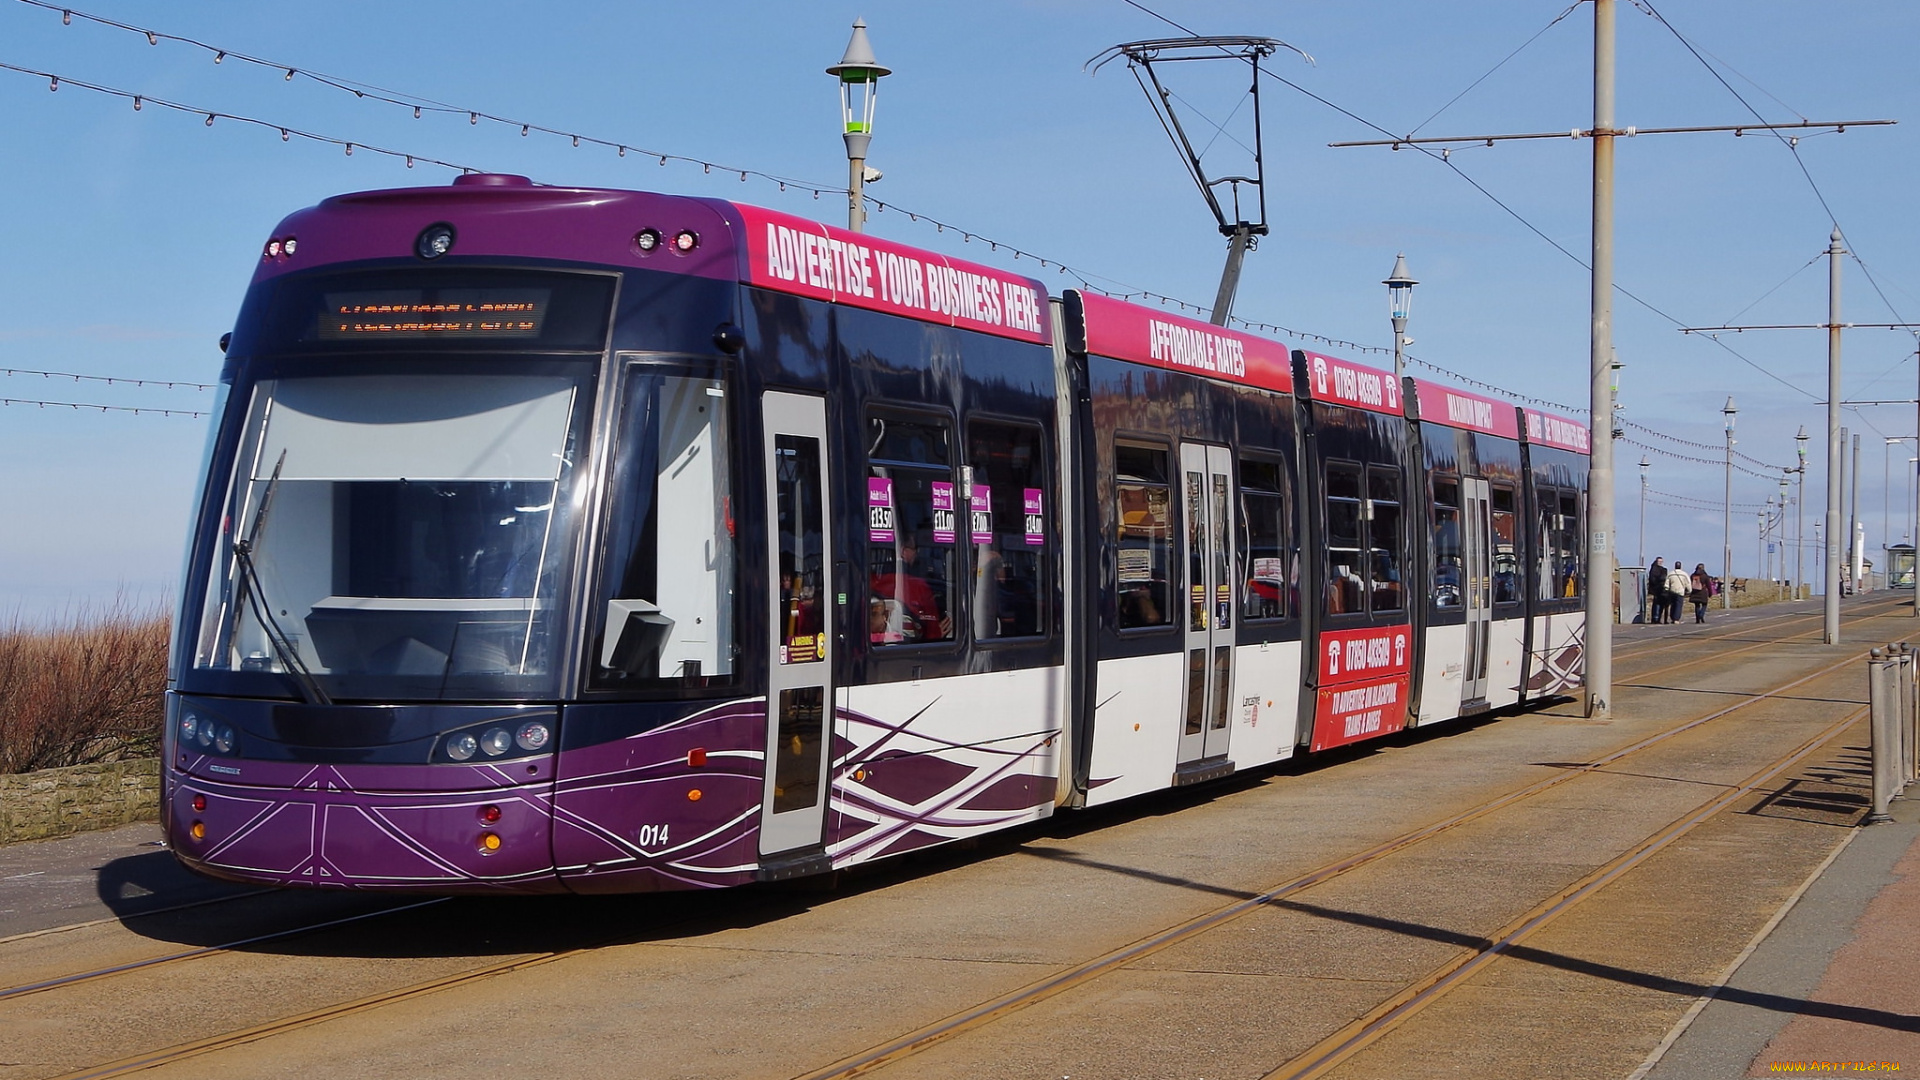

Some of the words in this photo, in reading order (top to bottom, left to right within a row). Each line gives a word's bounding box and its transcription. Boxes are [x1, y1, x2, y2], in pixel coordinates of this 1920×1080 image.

[766, 222, 874, 299] ADVERTISE
[874, 249, 926, 310] YOUR
[926, 262, 1001, 327] BUSINESS
[1002, 281, 1042, 334] HERE
[1149, 318, 1216, 372] AFFORDABLE
[1214, 334, 1246, 378] RATES
[871, 507, 892, 529] £13.50
[935, 510, 955, 531] £11.00
[972, 512, 988, 532] £7.00
[1345, 638, 1367, 672] 07850
[639, 824, 669, 847] 014
